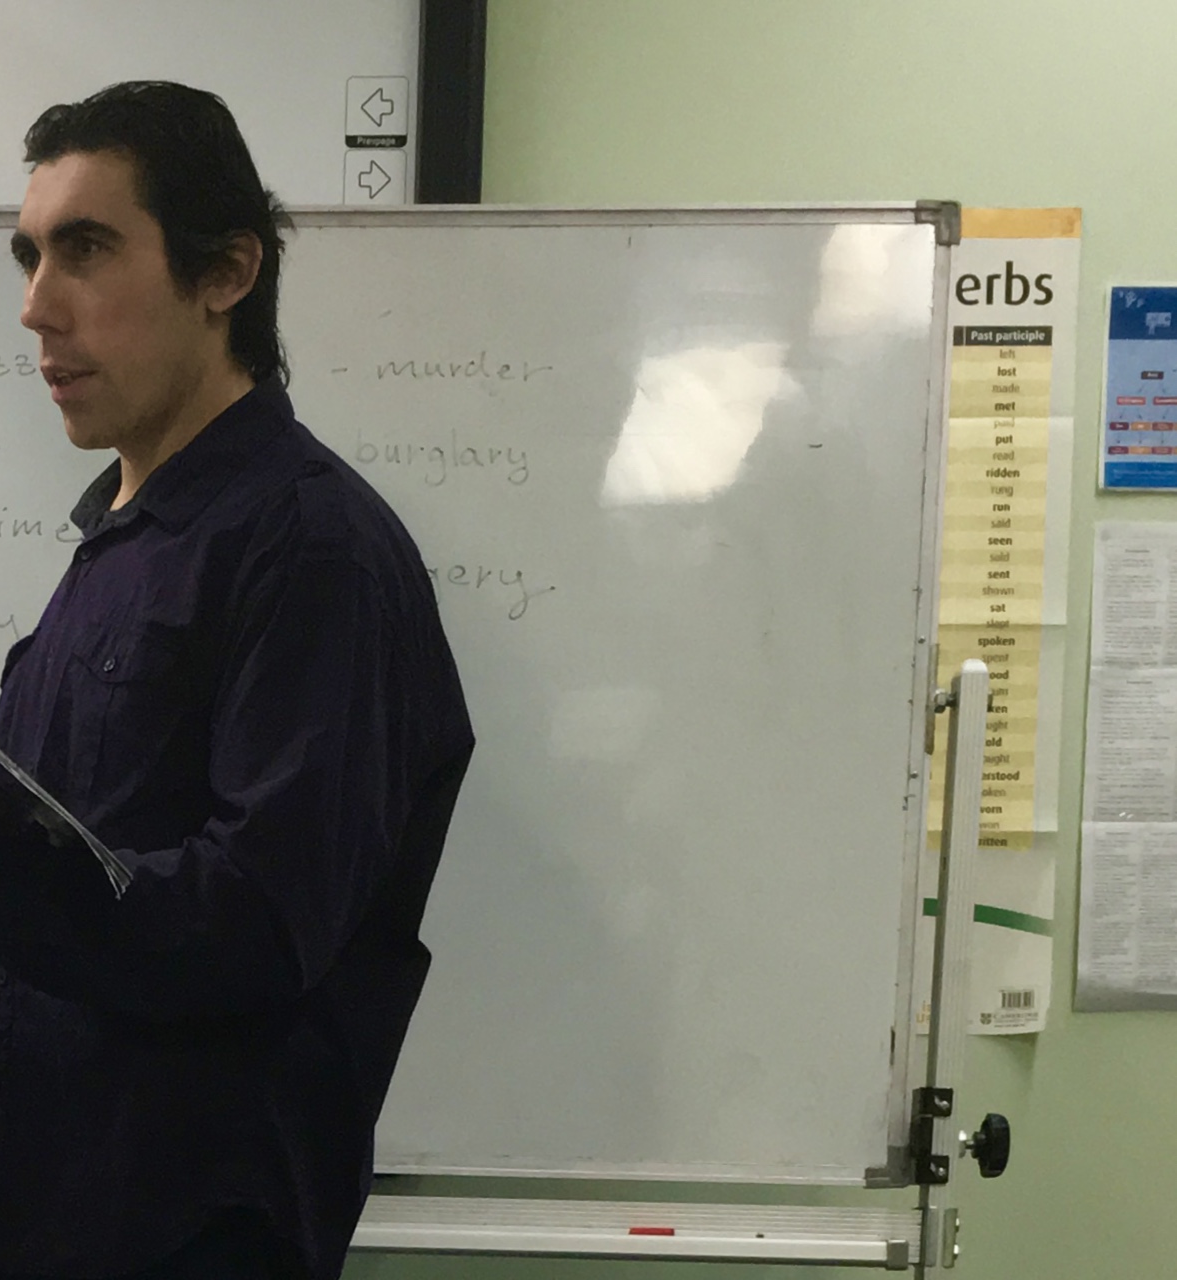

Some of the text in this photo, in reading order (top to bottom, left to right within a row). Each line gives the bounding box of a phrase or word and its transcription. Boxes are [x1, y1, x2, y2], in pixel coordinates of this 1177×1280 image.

[955, 260, 1054, 306] erbs
[971, 329, 1046, 344] Past participle
[376, 350, 553, 382] murder
[996, 365, 1018, 377] lost
[992, 383, 1021, 394] made
[994, 402, 1016, 411] met
[995, 434, 1014, 446] put
[355, 428, 530, 487] burglary
[992, 451, 1015, 461] read
[985, 467, 1021, 478] ridden
[990, 485, 1014, 498] rung
[992, 503, 1011, 512] run
[990, 517, 1012, 529] said
[987, 536, 1013, 546] seen
[987, 570, 1010, 580] sent
[982, 586, 1015, 596] shown
[989, 603, 1006, 613] sat
[977, 636, 1016, 648] spoken
[982, 652, 1010, 664] spent
[989, 669, 1010, 680] ood
[988, 703, 1009, 713] ken
[985, 719, 1009, 732] ught
[985, 736, 1003, 747] old
[982, 770, 1021, 781] erstood
[981, 786, 1007, 797] oken
[978, 835, 1008, 847] ritten
